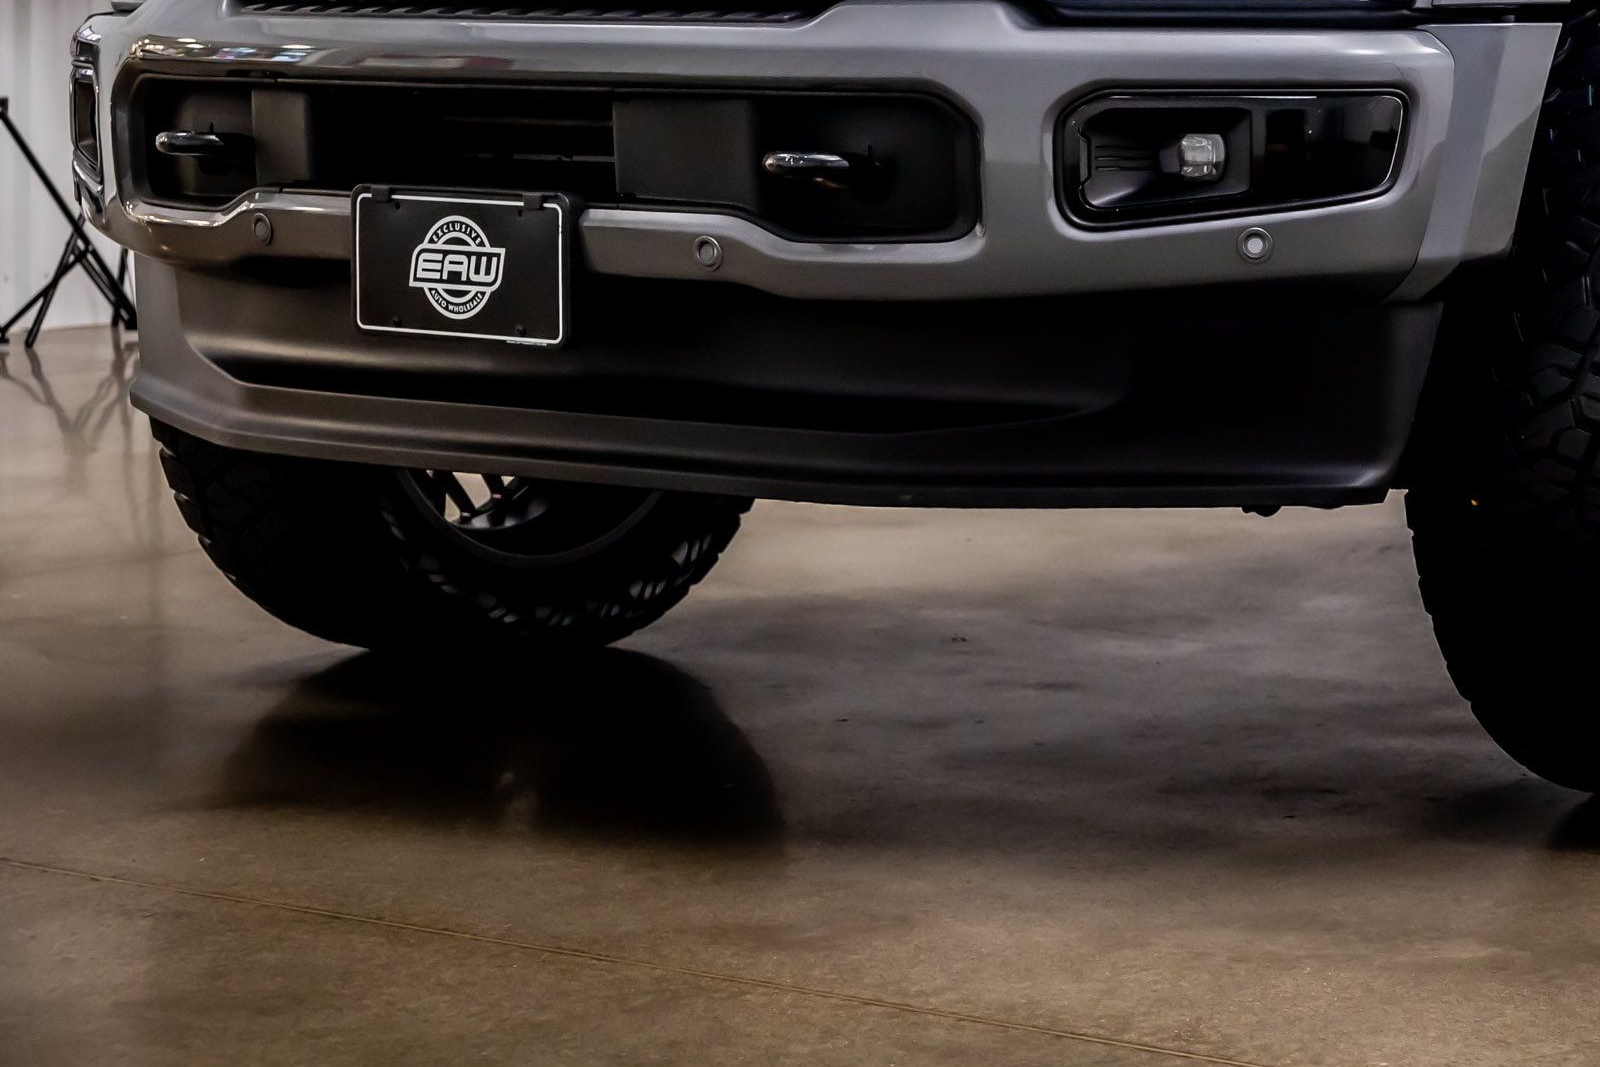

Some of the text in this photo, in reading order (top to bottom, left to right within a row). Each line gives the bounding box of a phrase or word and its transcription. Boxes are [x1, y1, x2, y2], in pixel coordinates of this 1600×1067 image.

[432, 222, 482, 246] EXCLUSIVE
[416, 252, 498, 283] EAW
[431, 290, 483, 313] AUTO WHOLESALE
